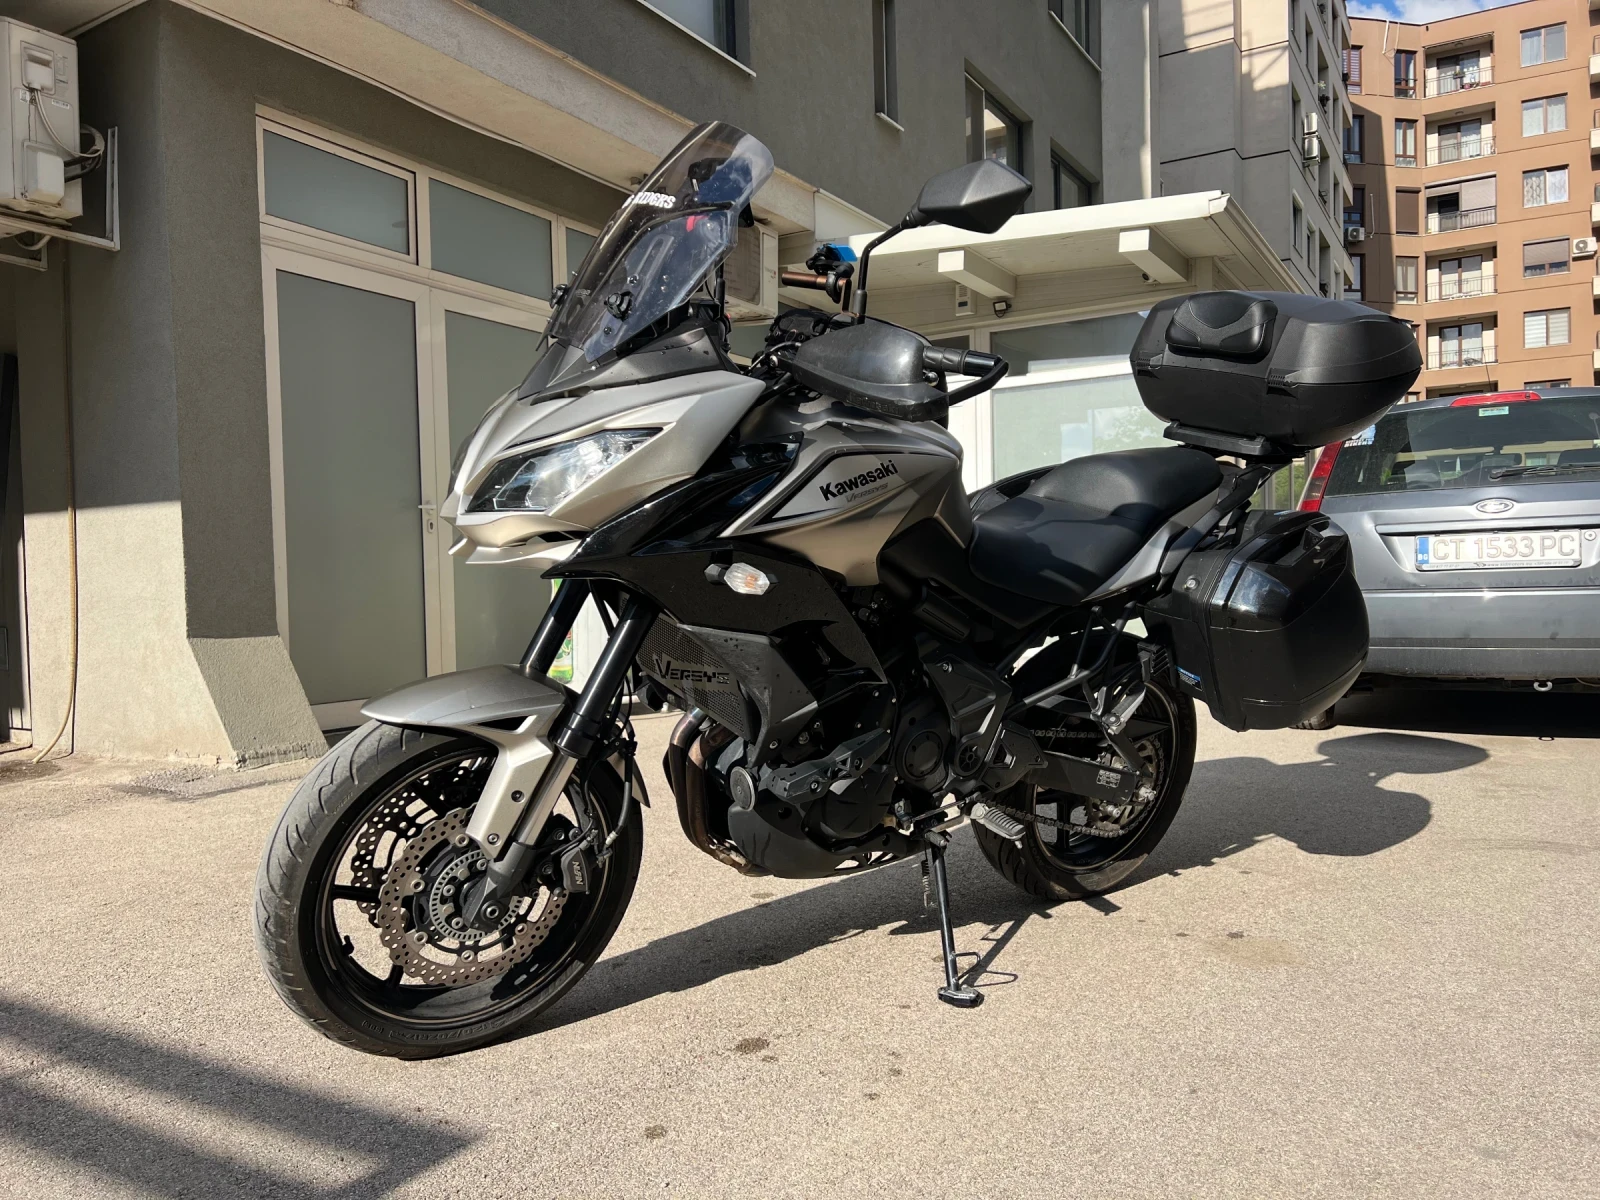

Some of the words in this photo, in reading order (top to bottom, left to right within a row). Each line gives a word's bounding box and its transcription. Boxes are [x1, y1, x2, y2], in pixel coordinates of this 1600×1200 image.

[819, 460, 899, 501] Kawasaki
[1433, 538, 1465, 560] CT
[1474, 536, 1534, 559] 1533
[1539, 534, 1575, 557] PC
